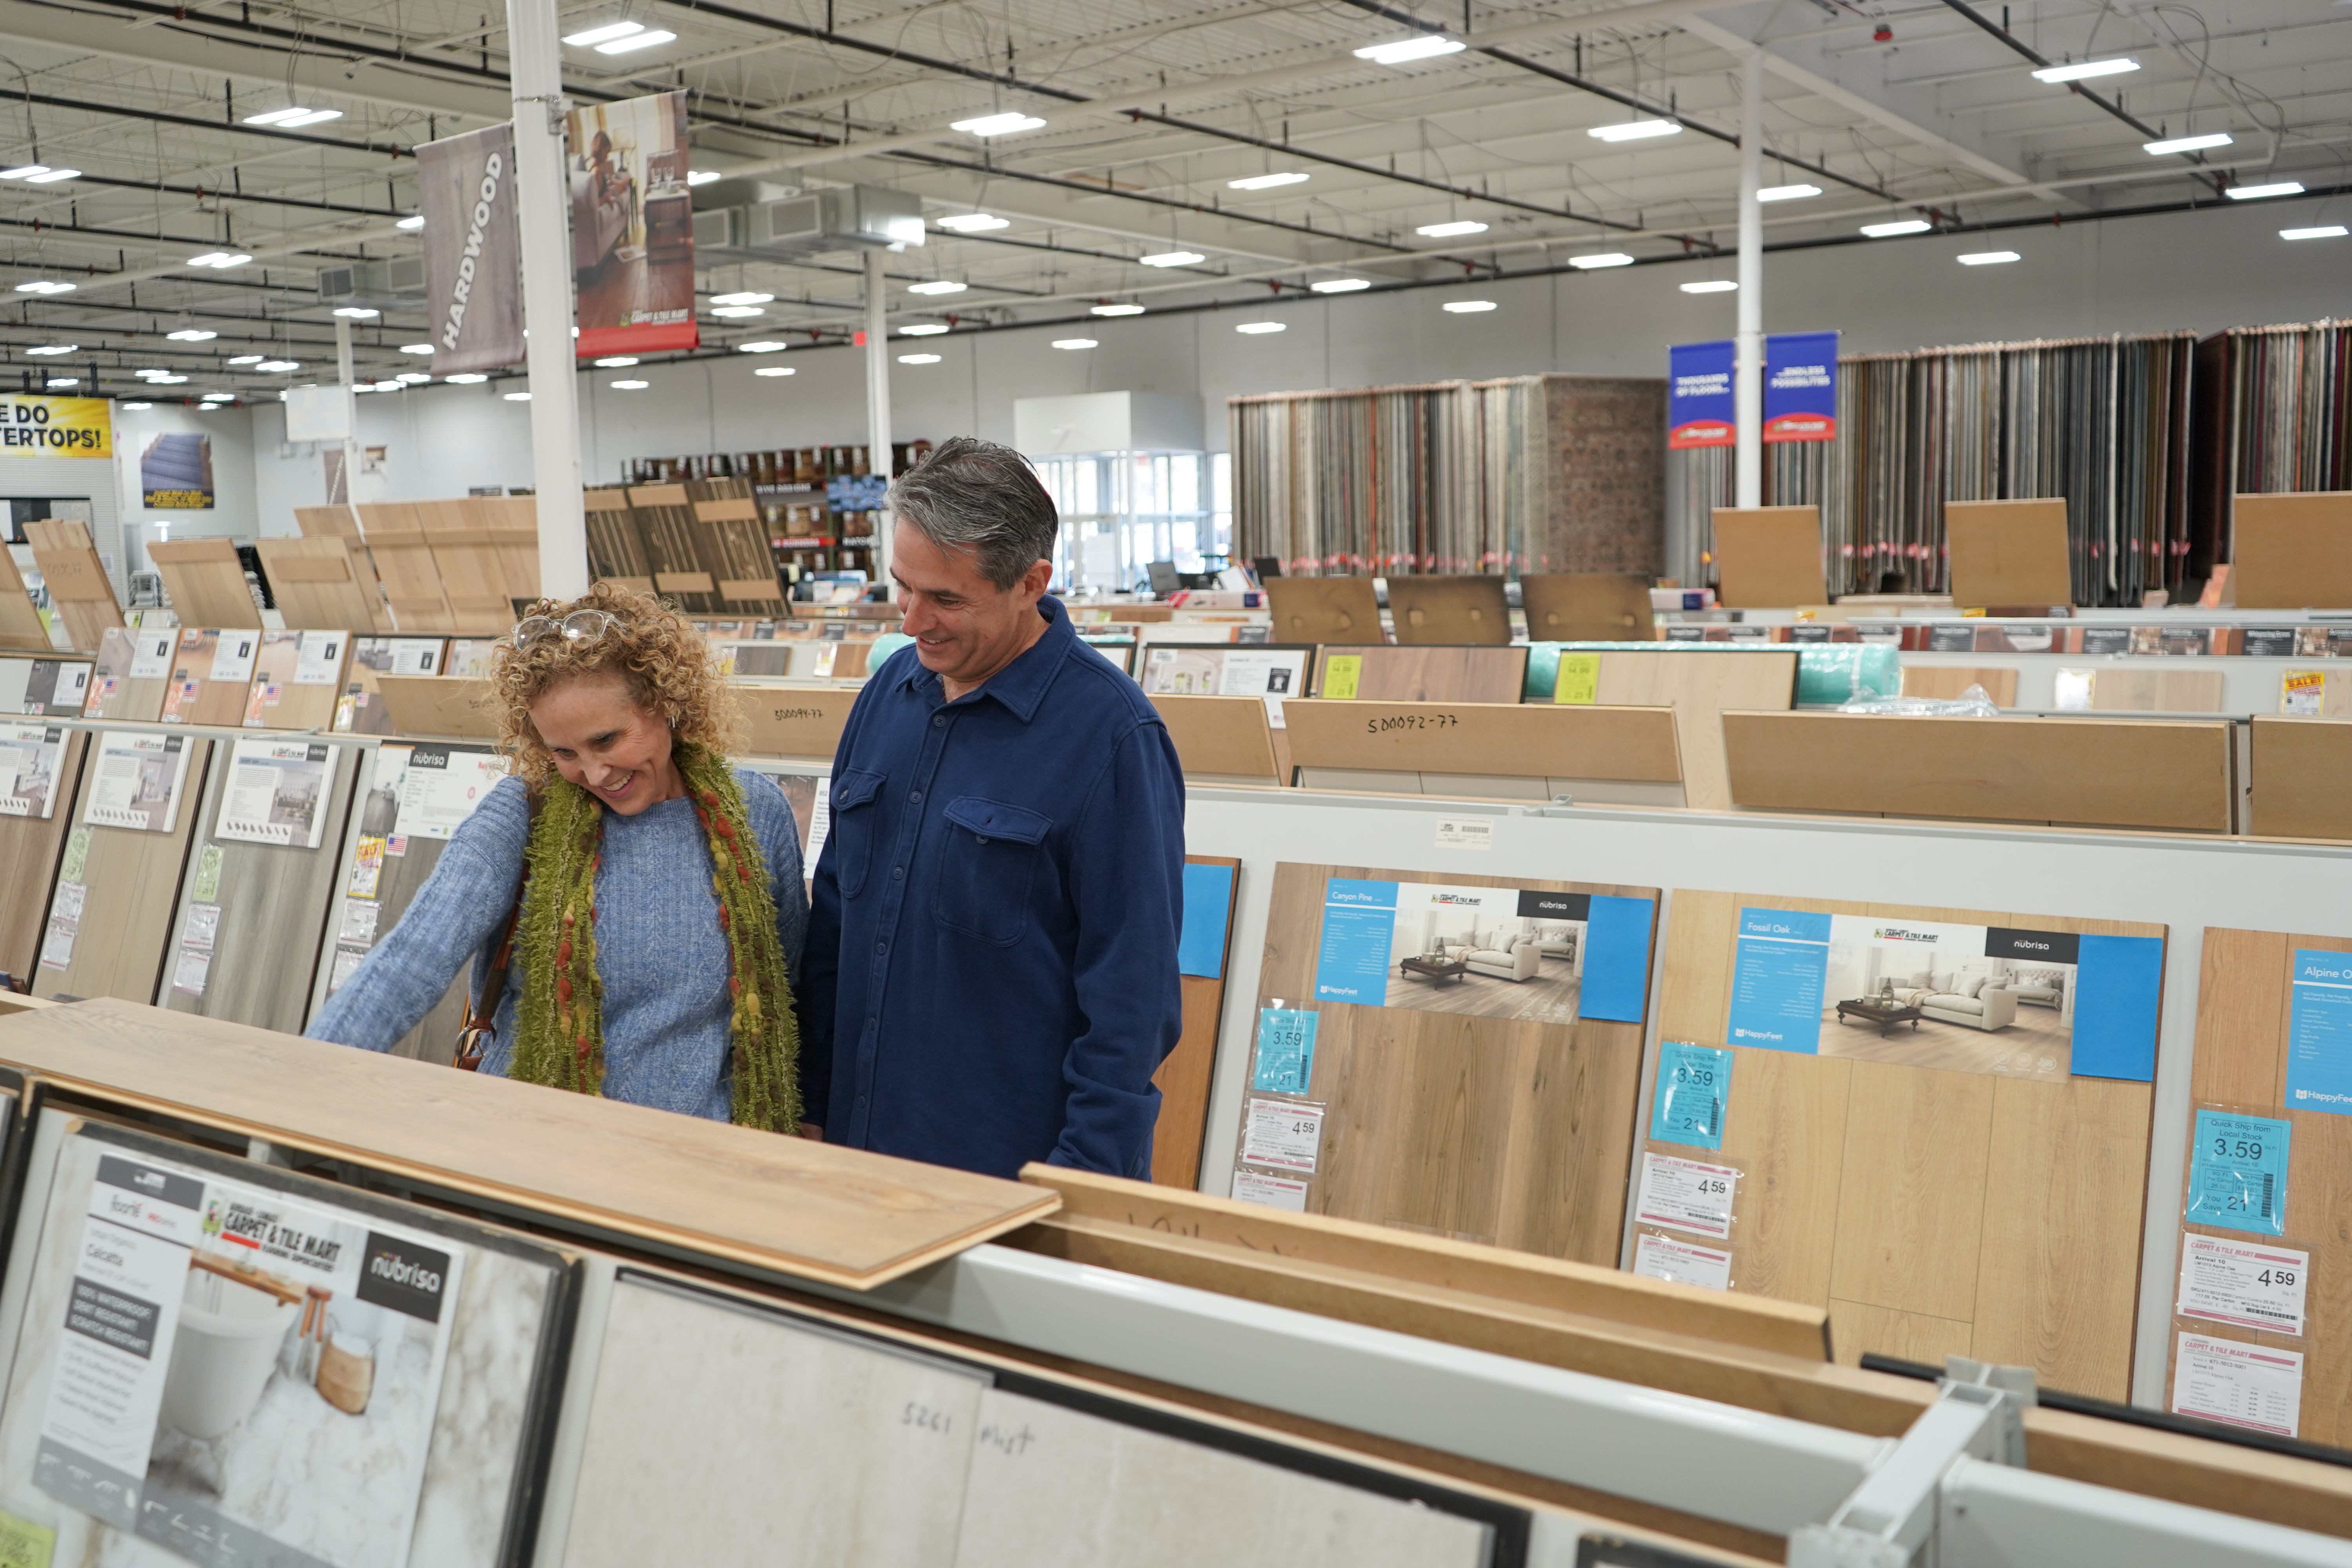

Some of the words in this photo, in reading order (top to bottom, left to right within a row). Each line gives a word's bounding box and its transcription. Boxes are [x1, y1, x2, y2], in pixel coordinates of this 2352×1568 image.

[442, 152, 502, 350] HARDWOOD
[1676, 373, 1729, 387] THOUSANDS
[16, 405, 49, 424] DO
[0, 428, 101, 448] ERTOPS!
[776, 482, 811, 493] DESIGNS
[782, 537, 820, 548] RUNNERS
[1332, 891, 1357, 904] Canyon
[1358, 893, 1373, 902] Pine
[1747, 922, 1771, 932] Fossil
[1773, 924, 1791, 934] Oak
[2305, 966, 2339, 979] Alpine
[1273, 1031, 1302, 1046] 3.59
[1744, 1029, 1783, 1040] HappyFeet
[1279, 1075, 1292, 1085] 21
[1677, 1067, 1713, 1086] 3.59
[1292, 1122, 1300, 1135] 4
[1303, 1123, 1315, 1133] 59
[2211, 1119, 2232, 1128] Quick
[2235, 1122, 2252, 1131] Ship
[2254, 1124, 2271, 1132] from
[2220, 1130, 2240, 1138] Local
[2241, 1132, 2263, 1141] Stock
[2214, 1138, 2262, 1160] 3.59
[1650, 1156, 1668, 1165] CARPET
[1698, 1180, 1708, 1194] 4
[1711, 1180, 1726, 1194] 59
[2203, 1203, 2222, 1211] Save
[2227, 1196, 2246, 1211] 21
[225, 1212, 267, 1240] CARPET
[279, 1228, 303, 1251] TILE
[303, 1236, 341, 1262] MART
[2191, 1243, 2214, 1251] CARPET
[370, 1255, 441, 1293] nubrisa
[2258, 1269, 2271, 1287] 4
[2275, 1271, 2295, 1286] 59
[2185, 1341, 2209, 1350] CARPET
[2229, 1349, 2248, 1358] MART
[2209, 1359, 2246, 1370] 671-5012-5001
[902, 1401, 951, 1435] 5261
